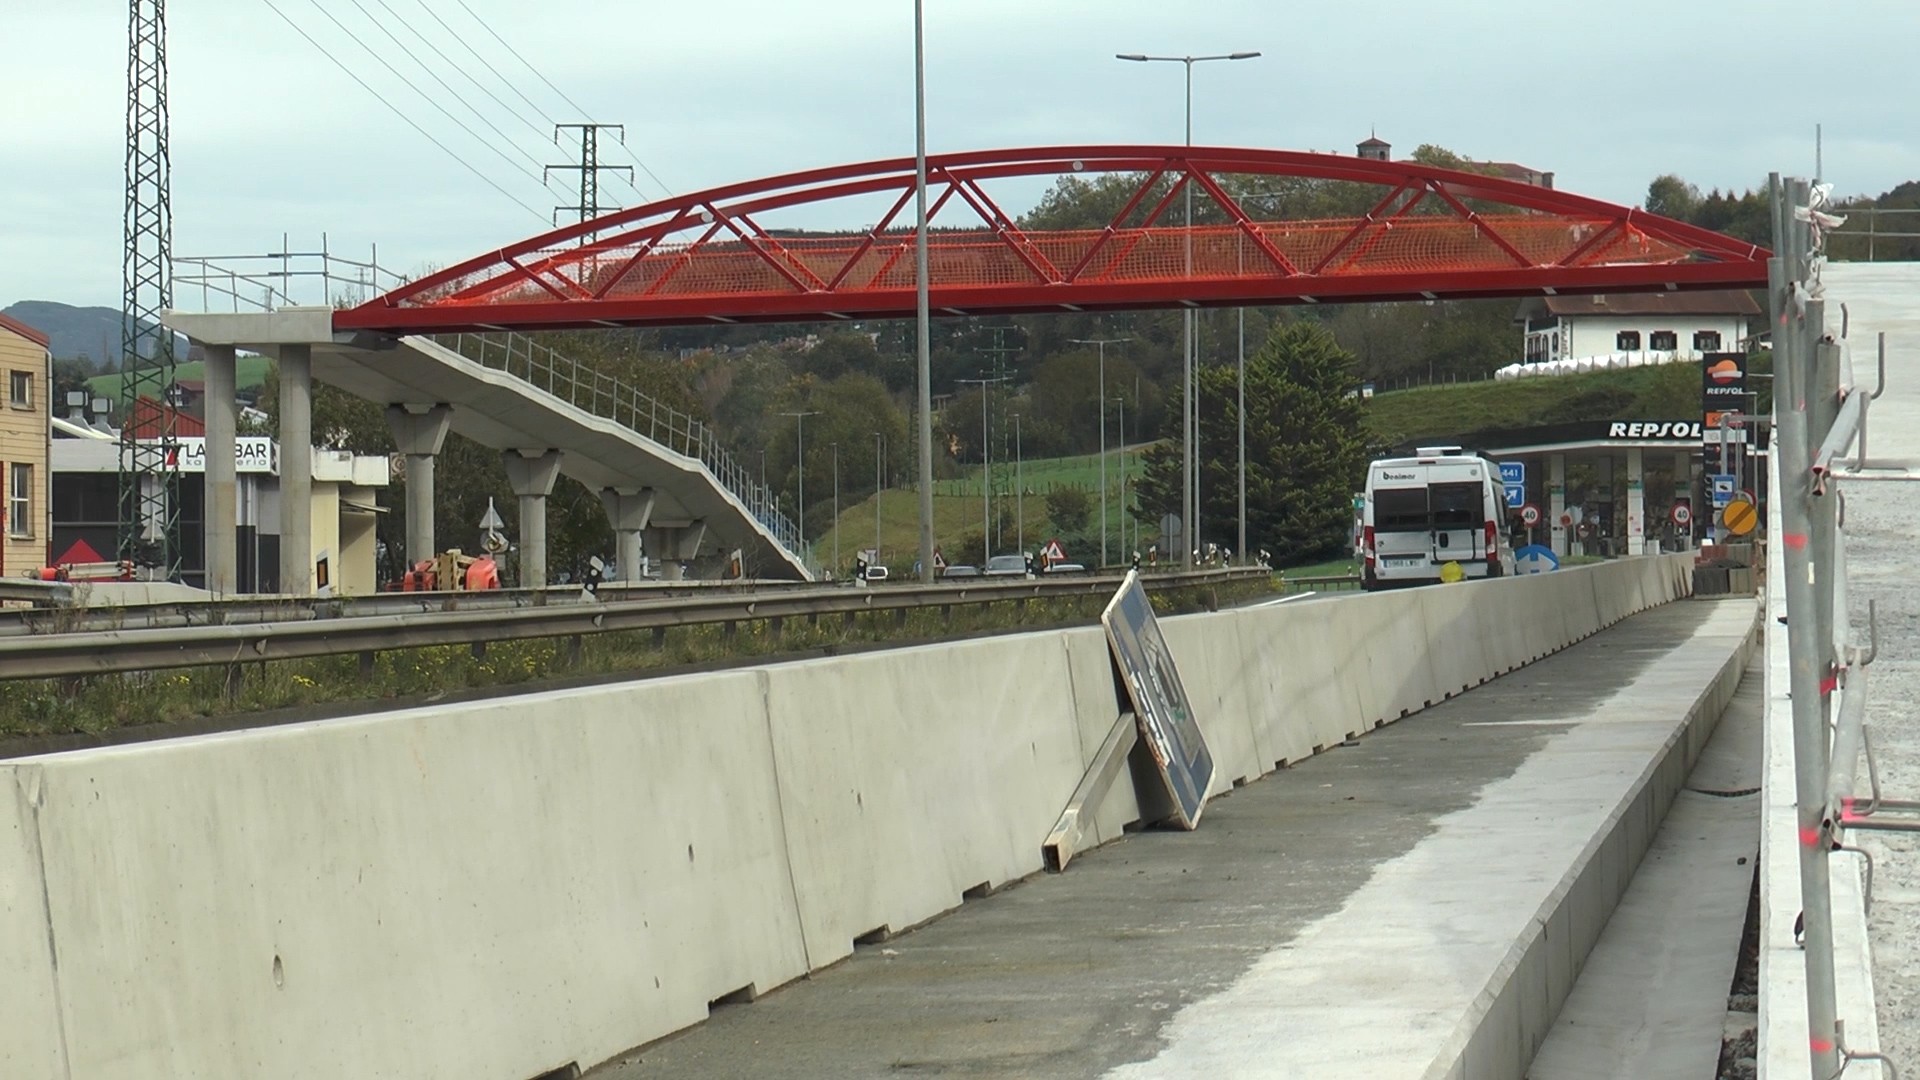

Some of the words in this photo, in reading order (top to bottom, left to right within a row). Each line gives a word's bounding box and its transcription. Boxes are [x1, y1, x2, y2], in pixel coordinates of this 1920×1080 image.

[1706, 387, 1743, 395] REPSOL
[1609, 422, 1702, 437] REPSOL
[1524, 511, 1536, 519] 40
[1676, 510, 1688, 519] 40
